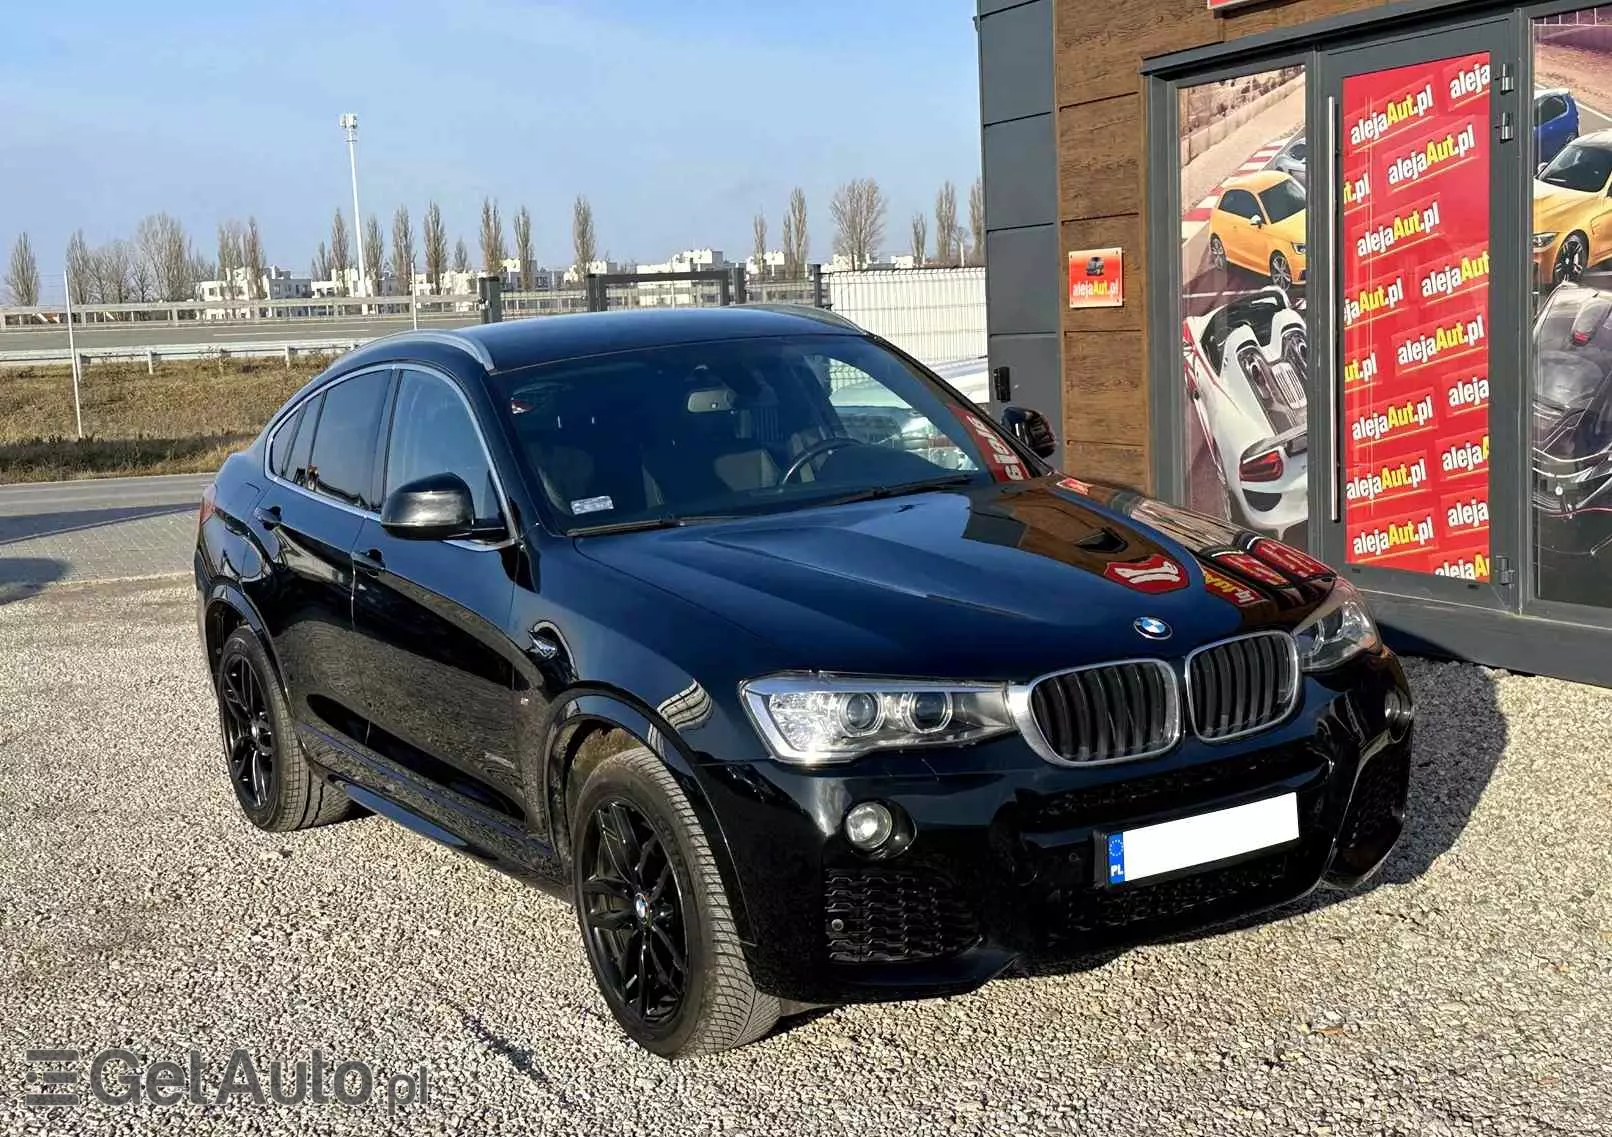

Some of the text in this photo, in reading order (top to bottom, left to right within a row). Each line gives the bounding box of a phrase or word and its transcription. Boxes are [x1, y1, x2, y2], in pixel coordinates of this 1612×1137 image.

[1450, 63, 1490, 99] aleja
[1350, 85, 1434, 145] alejaAut.pl
[1388, 124, 1476, 184] alejaAut.pl
[1357, 202, 1440, 257] alejaAut.pl
[1421, 250, 1489, 297] alejaAut
[1344, 277, 1404, 326] jaAut.pl
[1397, 315, 1484, 366] alejaAut.pl
[1448, 376, 1489, 407] aleja
[1352, 395, 1433, 441] alejaAut.pl
[1346, 458, 1427, 500] alejaAut.pl
[1353, 516, 1434, 555] alejaAut.pl
[1447, 499, 1489, 528] aleja
[1110, 864, 1124, 877] PL
